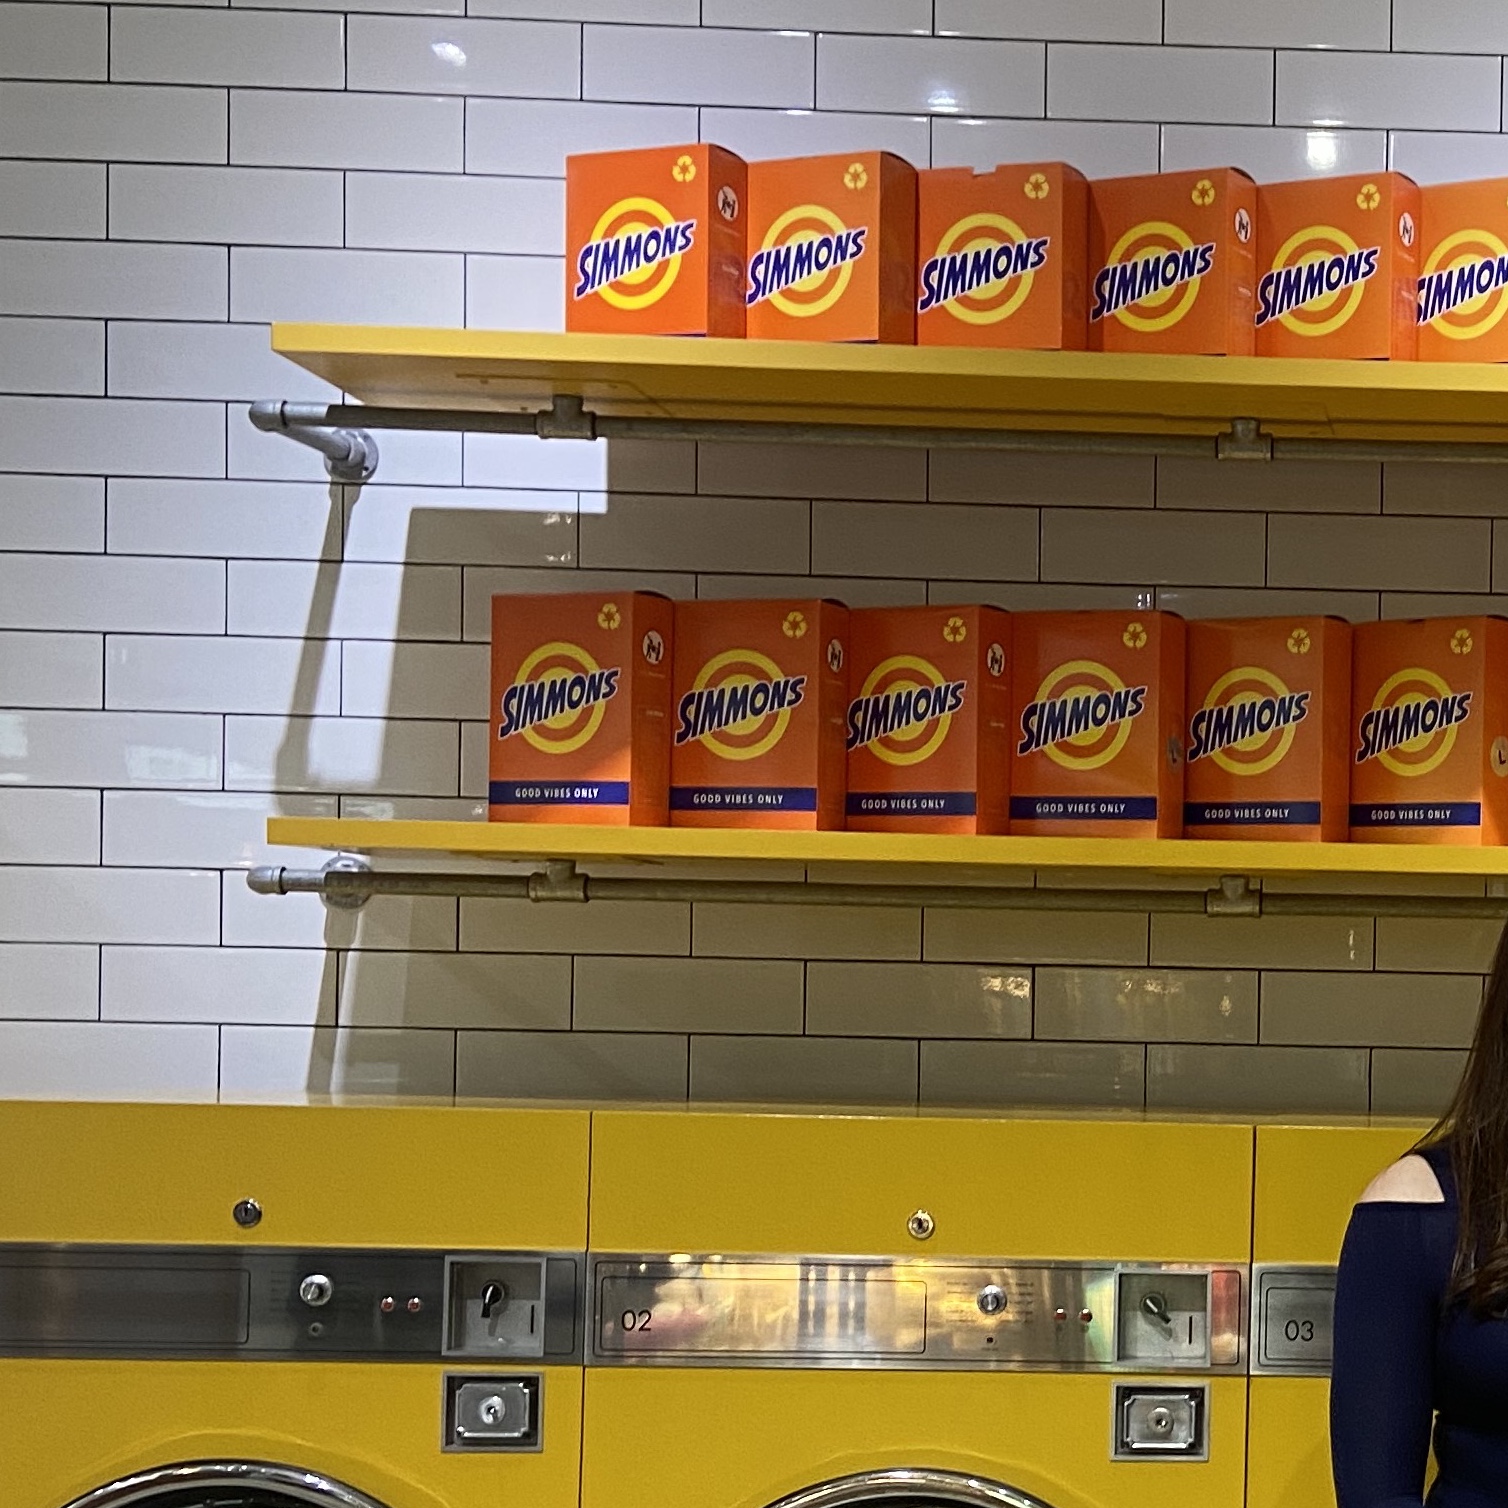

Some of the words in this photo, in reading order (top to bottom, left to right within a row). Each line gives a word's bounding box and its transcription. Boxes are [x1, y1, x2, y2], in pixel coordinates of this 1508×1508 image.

[575, 222, 695, 298] SIMMONS
[746, 229, 867, 305] SIMMONS
[916, 237, 1049, 313] SIMMONS
[1089, 243, 1215, 322] SIMMONS
[1254, 247, 1379, 327] SIMMONS
[499, 669, 620, 739] SIMMONS
[675, 676, 806, 745] SIMMONS
[845, 681, 966, 752] SIMMONS
[1017, 687, 1147, 755] SIMMONS
[1186, 692, 1310, 763] SIMMONS
[1355, 692, 1472, 763] SIMMONS
[515, 786, 541, 800] GOOD
[543, 786, 571, 800] VIBES
[573, 786, 599, 800] ONLY
[693, 792, 722, 806] GOOD
[724, 792, 754, 806] VIBES
[757, 792, 784, 806] ONLY
[861, 797, 888, 811] GOOD
[890, 797, 918, 811] VIBES
[920, 797, 945, 811] ONLY
[1035, 801, 1064, 815] GOOD
[1067, 801, 1096, 815] VIBES
[1099, 801, 1126, 815] ONLY
[1204, 807, 1231, 820] GOOD
[1234, 807, 1261, 820] VIBES
[1264, 807, 1290, 820] ONLY
[1371, 808, 1396, 821] GOOD
[1398, 808, 1425, 821] VIBES
[1427, 808, 1451, 821] ONLY
[621, 1309, 652, 1332] 02
[1284, 1320, 1315, 1343] 03
